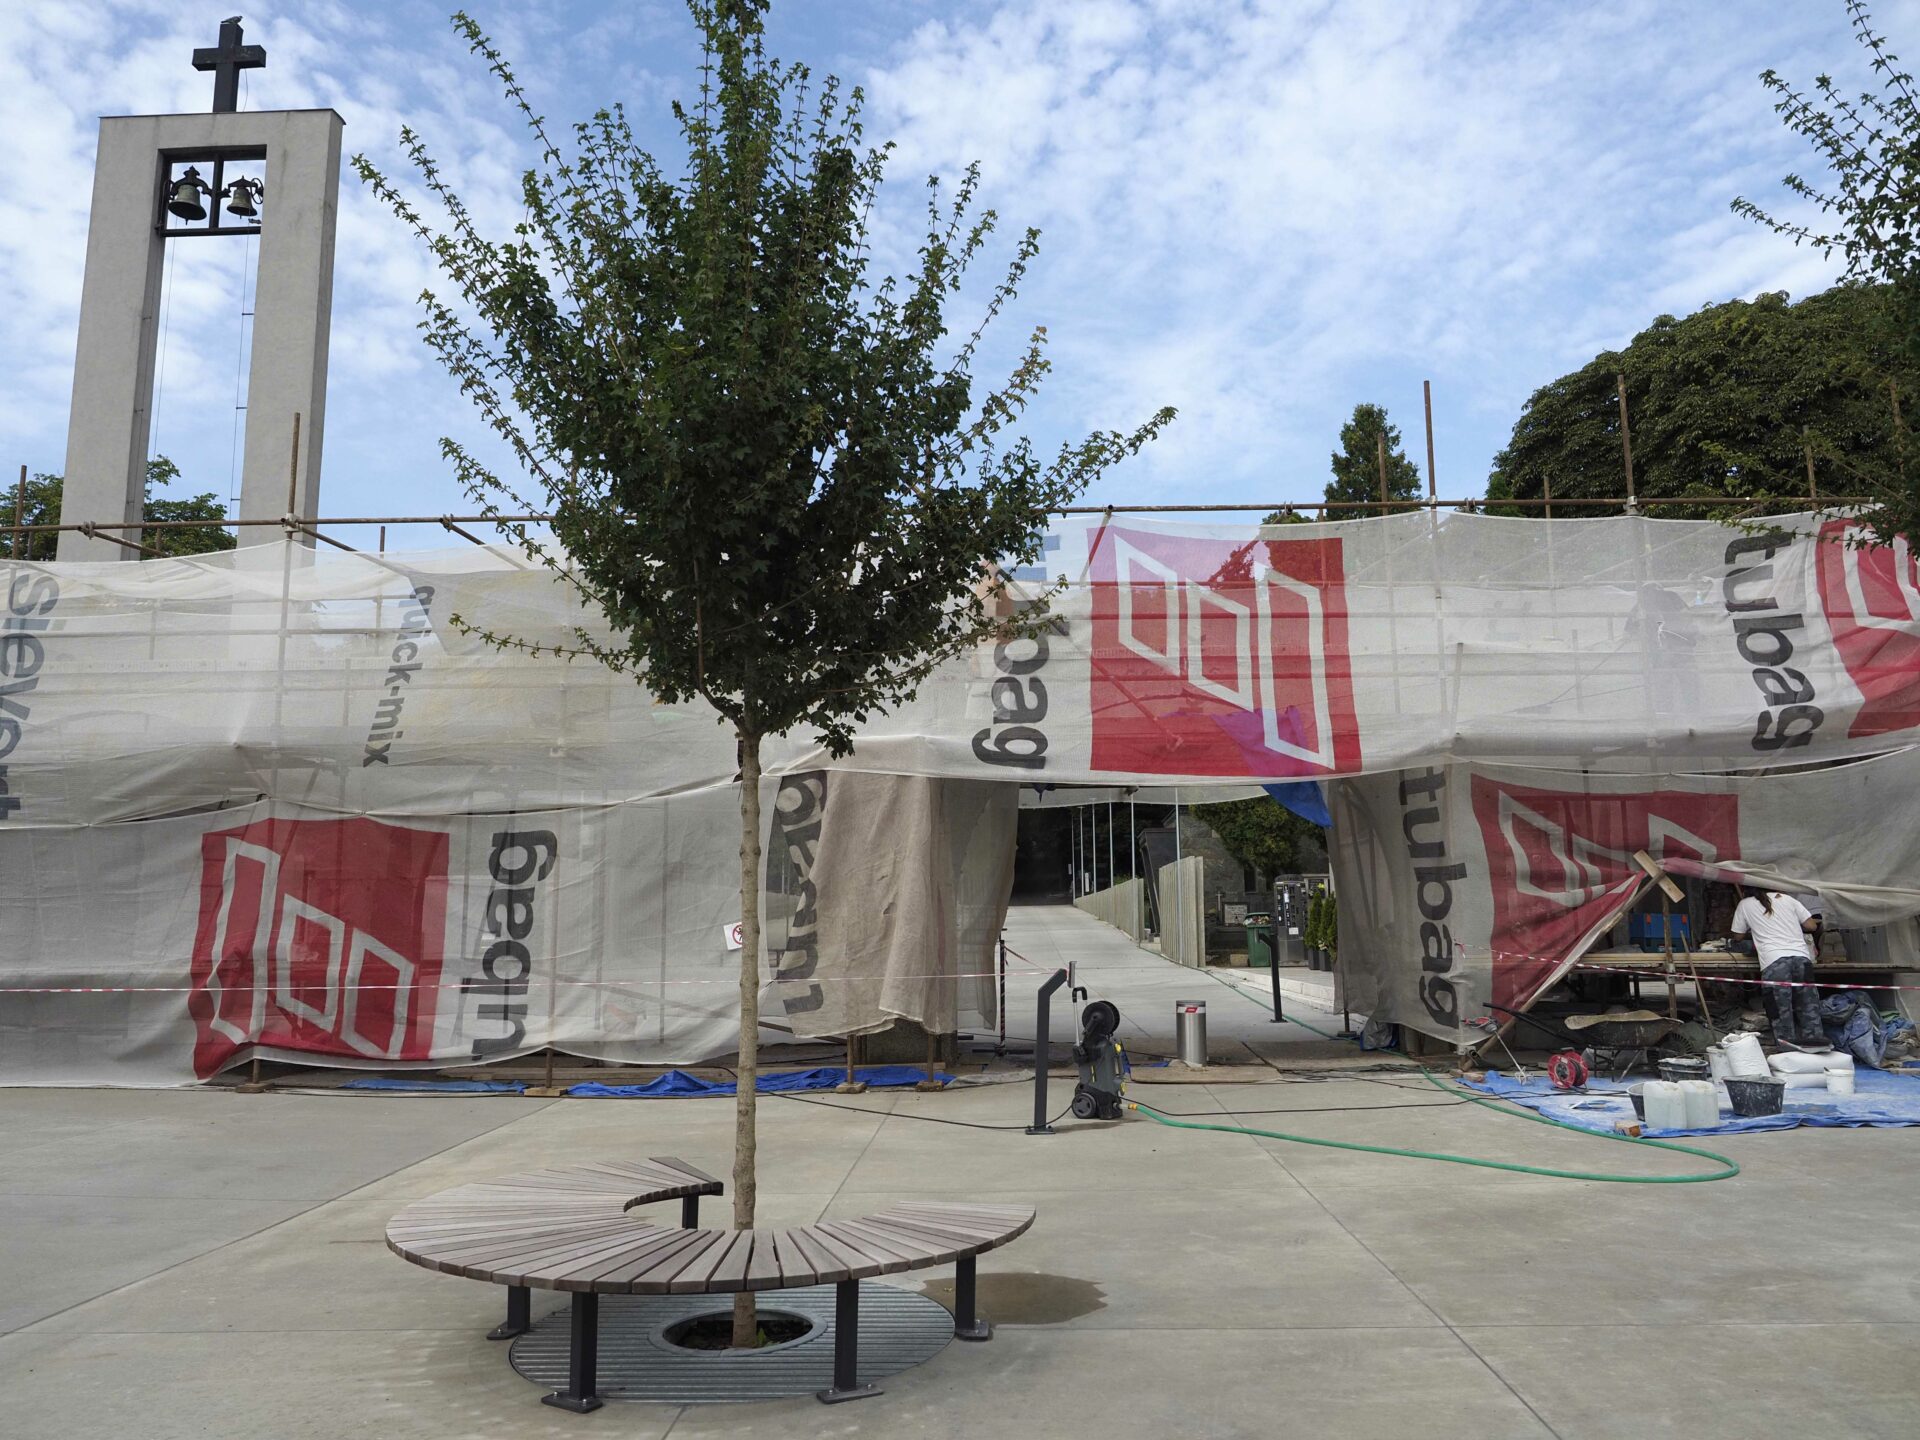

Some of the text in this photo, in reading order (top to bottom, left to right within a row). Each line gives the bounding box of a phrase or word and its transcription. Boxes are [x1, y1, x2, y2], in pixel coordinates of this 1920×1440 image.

[362, 585, 435, 768] quick-mix
[1722, 531, 1825, 751] tubag
[460, 829, 558, 1061] ubag
[1399, 766, 1468, 1030] tubag
